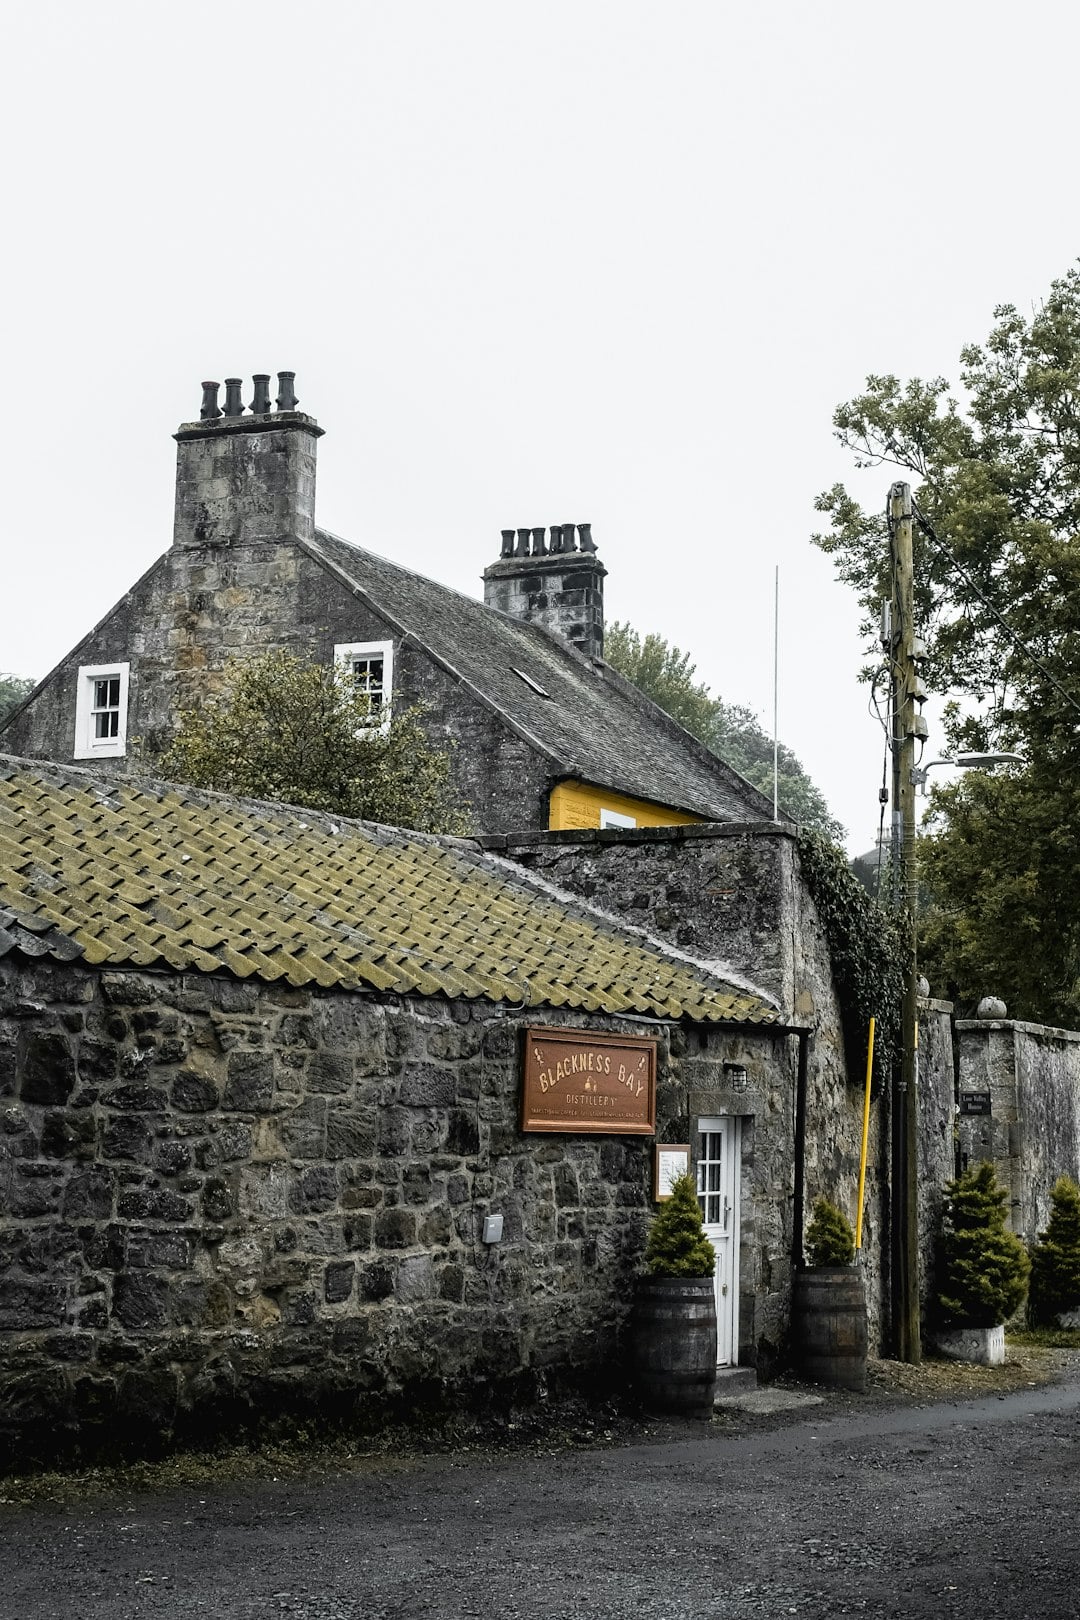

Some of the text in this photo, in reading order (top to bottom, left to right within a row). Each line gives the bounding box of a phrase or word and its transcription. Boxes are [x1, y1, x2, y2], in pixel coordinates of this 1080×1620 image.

[539, 1052, 645, 1098] BLACKNESS BAY
[566, 1094, 617, 1107] DISTILLERY
